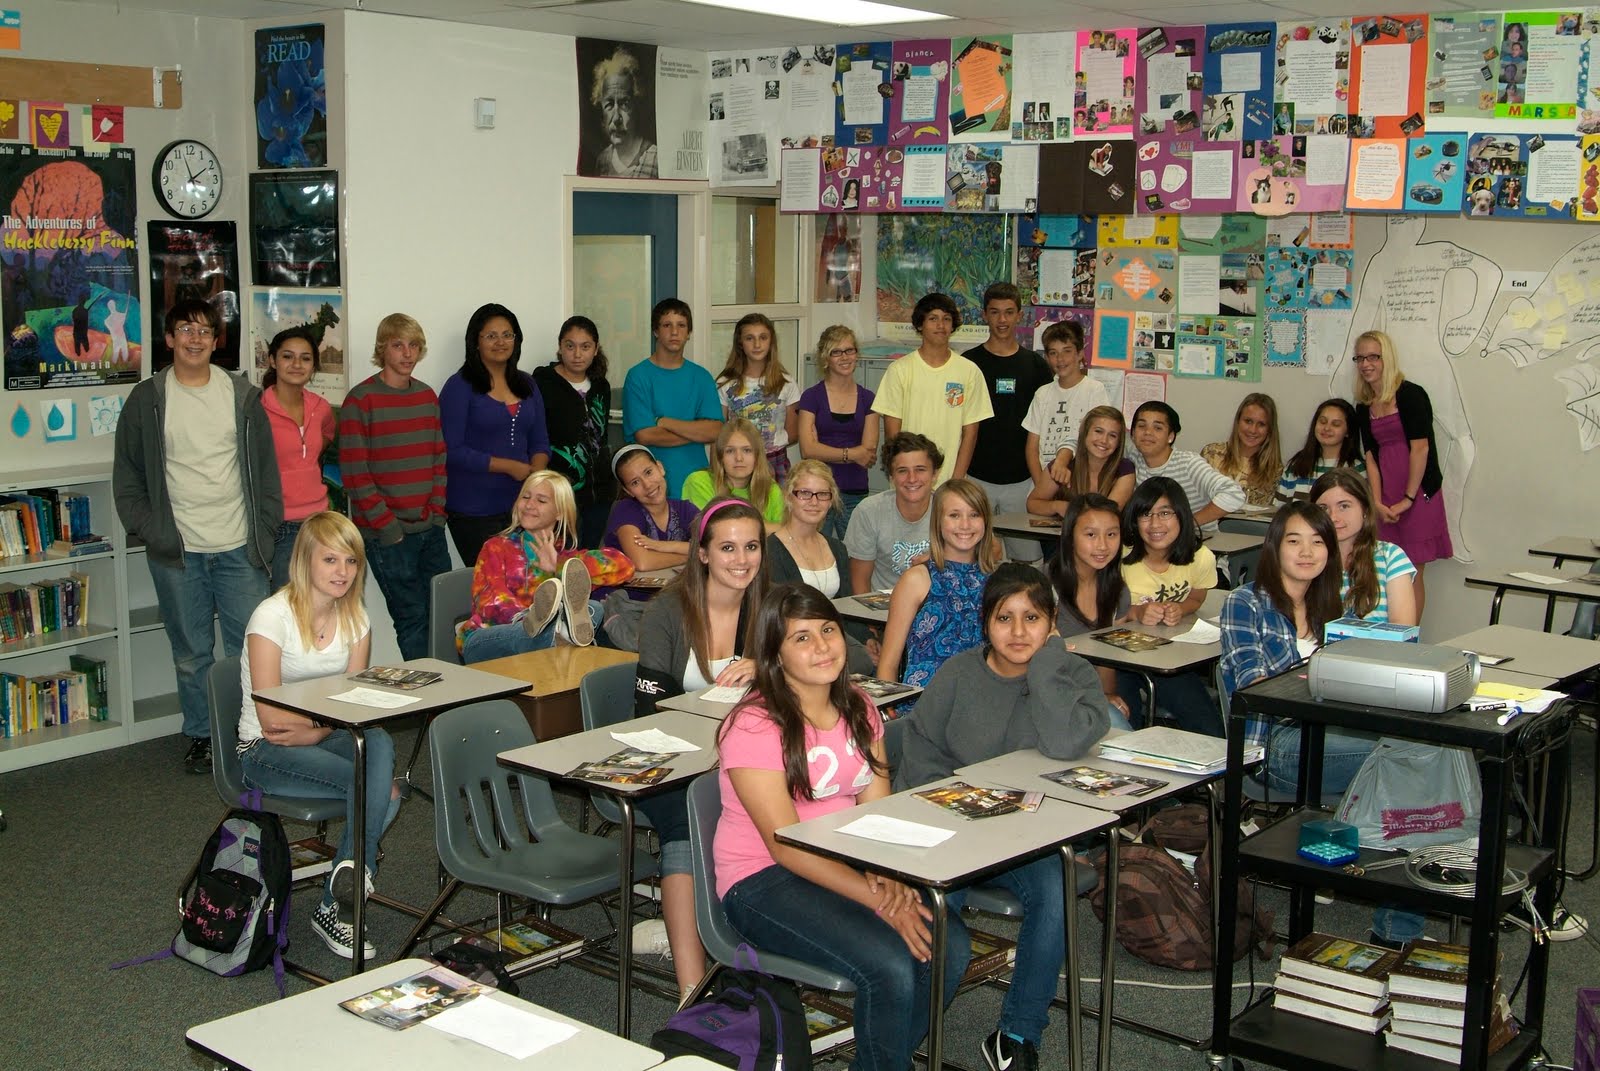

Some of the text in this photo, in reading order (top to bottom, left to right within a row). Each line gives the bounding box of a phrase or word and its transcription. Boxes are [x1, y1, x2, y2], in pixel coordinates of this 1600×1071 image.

[267, 41, 312, 63] READ
[174, 149, 182, 160] 11
[185, 145, 195, 155] 12
[200, 150, 204, 160] 1
[164, 160, 174, 170] 10
[208, 160, 215, 170] 2
[162, 175, 169, 186] 9
[212, 174, 219, 185] 3
[167, 189, 173, 200] 8
[209, 189, 215, 198] 4
[178, 201, 184, 211] 7
[190, 204, 196, 214] 6
[201, 200, 207, 211] 5
[2, 215, 97, 230] The Adventures of
[4, 230, 136, 253] Huckleberry Finn
[1511, 280, 1528, 288] End
[39, 360, 111, 373] Mark Twain
[1056, 401, 1067, 414] I
